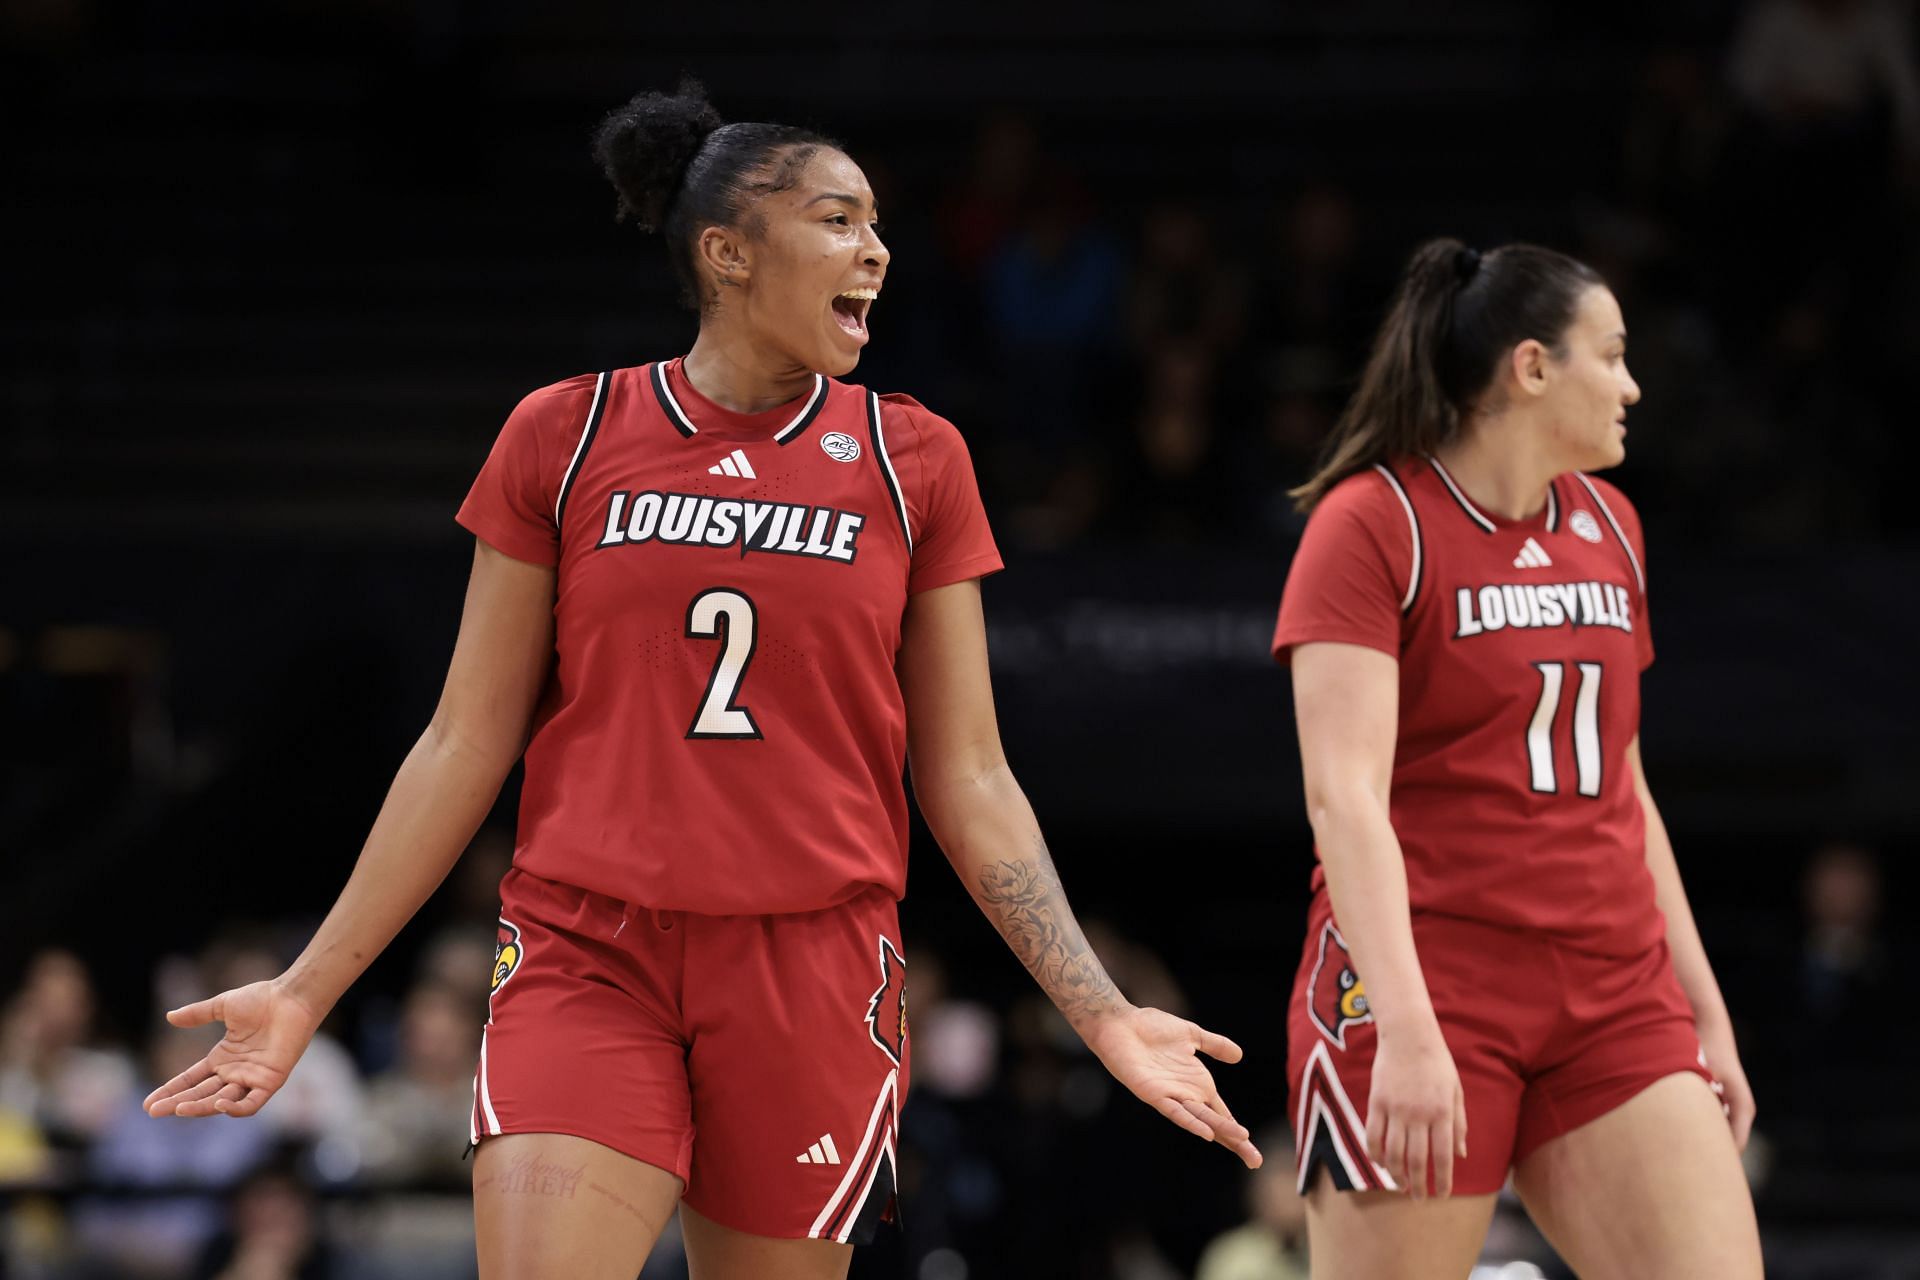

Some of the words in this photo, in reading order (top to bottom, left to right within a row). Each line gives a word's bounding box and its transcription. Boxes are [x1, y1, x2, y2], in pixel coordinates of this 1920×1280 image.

[825, 440, 858, 453] ACC
[596, 491, 865, 564] LOUISVILLE
[1454, 582, 1633, 638] LOUISVILLE
[685, 587, 764, 740] 2
[1528, 661, 1602, 797] 11
